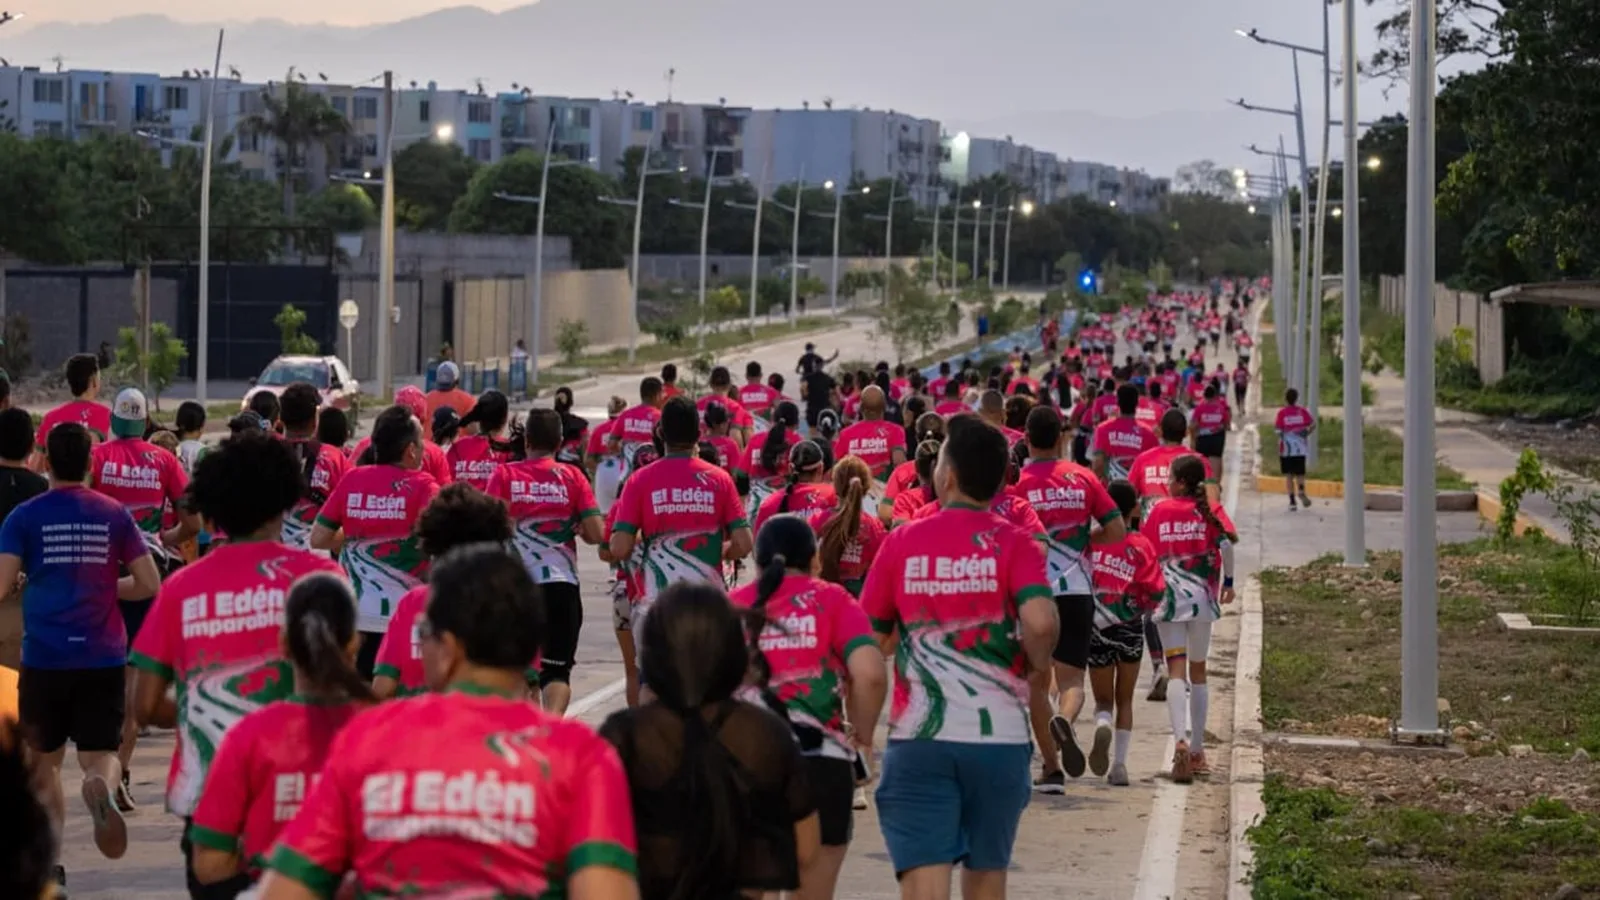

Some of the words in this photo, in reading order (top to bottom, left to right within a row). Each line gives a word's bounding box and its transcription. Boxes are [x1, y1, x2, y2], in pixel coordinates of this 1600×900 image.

[347, 493, 363, 508] El
[366, 493, 406, 510] Edén
[652, 488, 668, 505] El
[672, 486, 714, 504] Edén
[905, 553, 929, 579] El
[935, 553, 997, 579] Edén
[904, 577, 998, 597] Imparable
[183, 592, 207, 622] El
[215, 584, 284, 617] Edén
[275, 772, 305, 802] El
[362, 772, 406, 812] El
[412, 769, 536, 820] Edén
